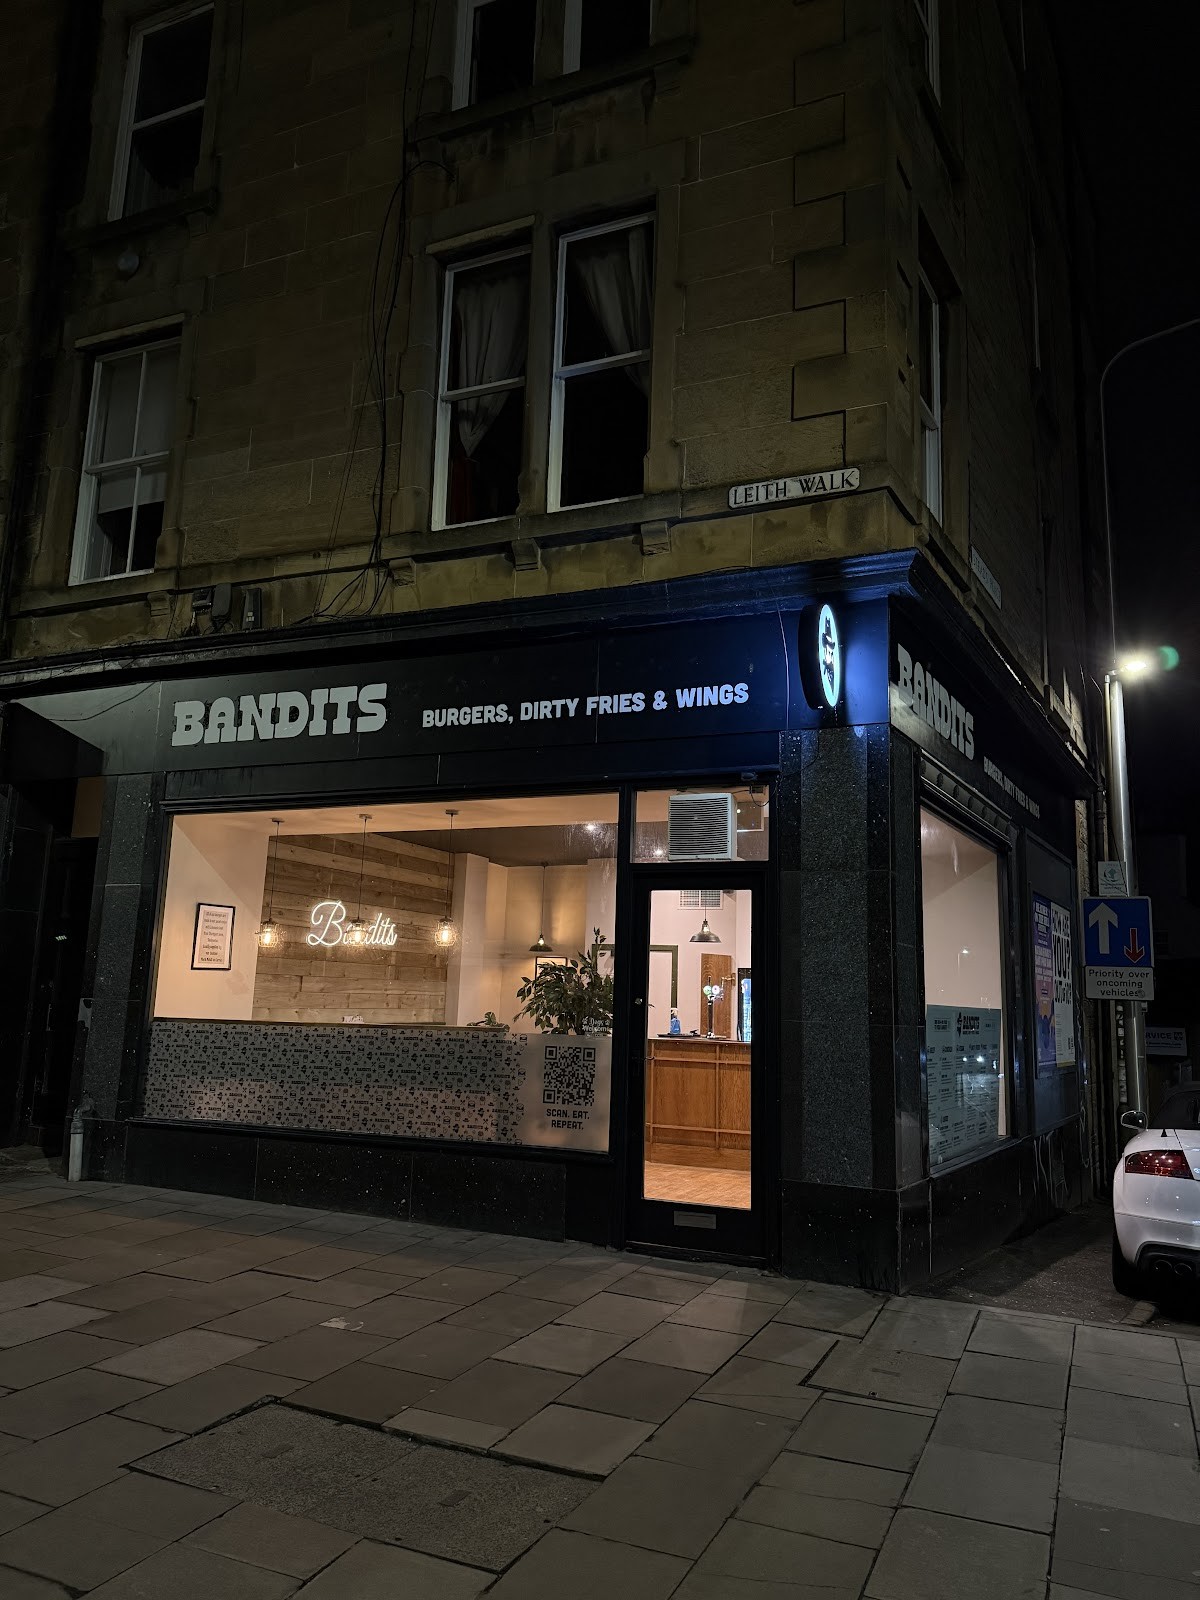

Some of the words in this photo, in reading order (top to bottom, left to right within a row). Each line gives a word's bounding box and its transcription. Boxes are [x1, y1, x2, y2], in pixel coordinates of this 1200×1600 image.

[734, 482, 787, 505] LEITH
[799, 471, 855, 494] WALK
[422, 703, 514, 728] BURGERS,
[520, 697, 580, 721] DIRTY
[586, 691, 646, 717] FRIES
[652, 690, 669, 711] &
[676, 682, 750, 708] WINGS
[897, 642, 975, 761] BANDITS
[172, 682, 389, 748] BANDITS
[1088, 969, 1124, 979] Priority
[1128, 970, 1150, 978] over
[1096, 979, 1143, 989] oncoming
[1100, 987, 1140, 997] vehicles
[546, 1108, 570, 1118] SCAN.
[572, 1110, 590, 1120] EAT.
[551, 1119, 584, 1131] REPEAT.
